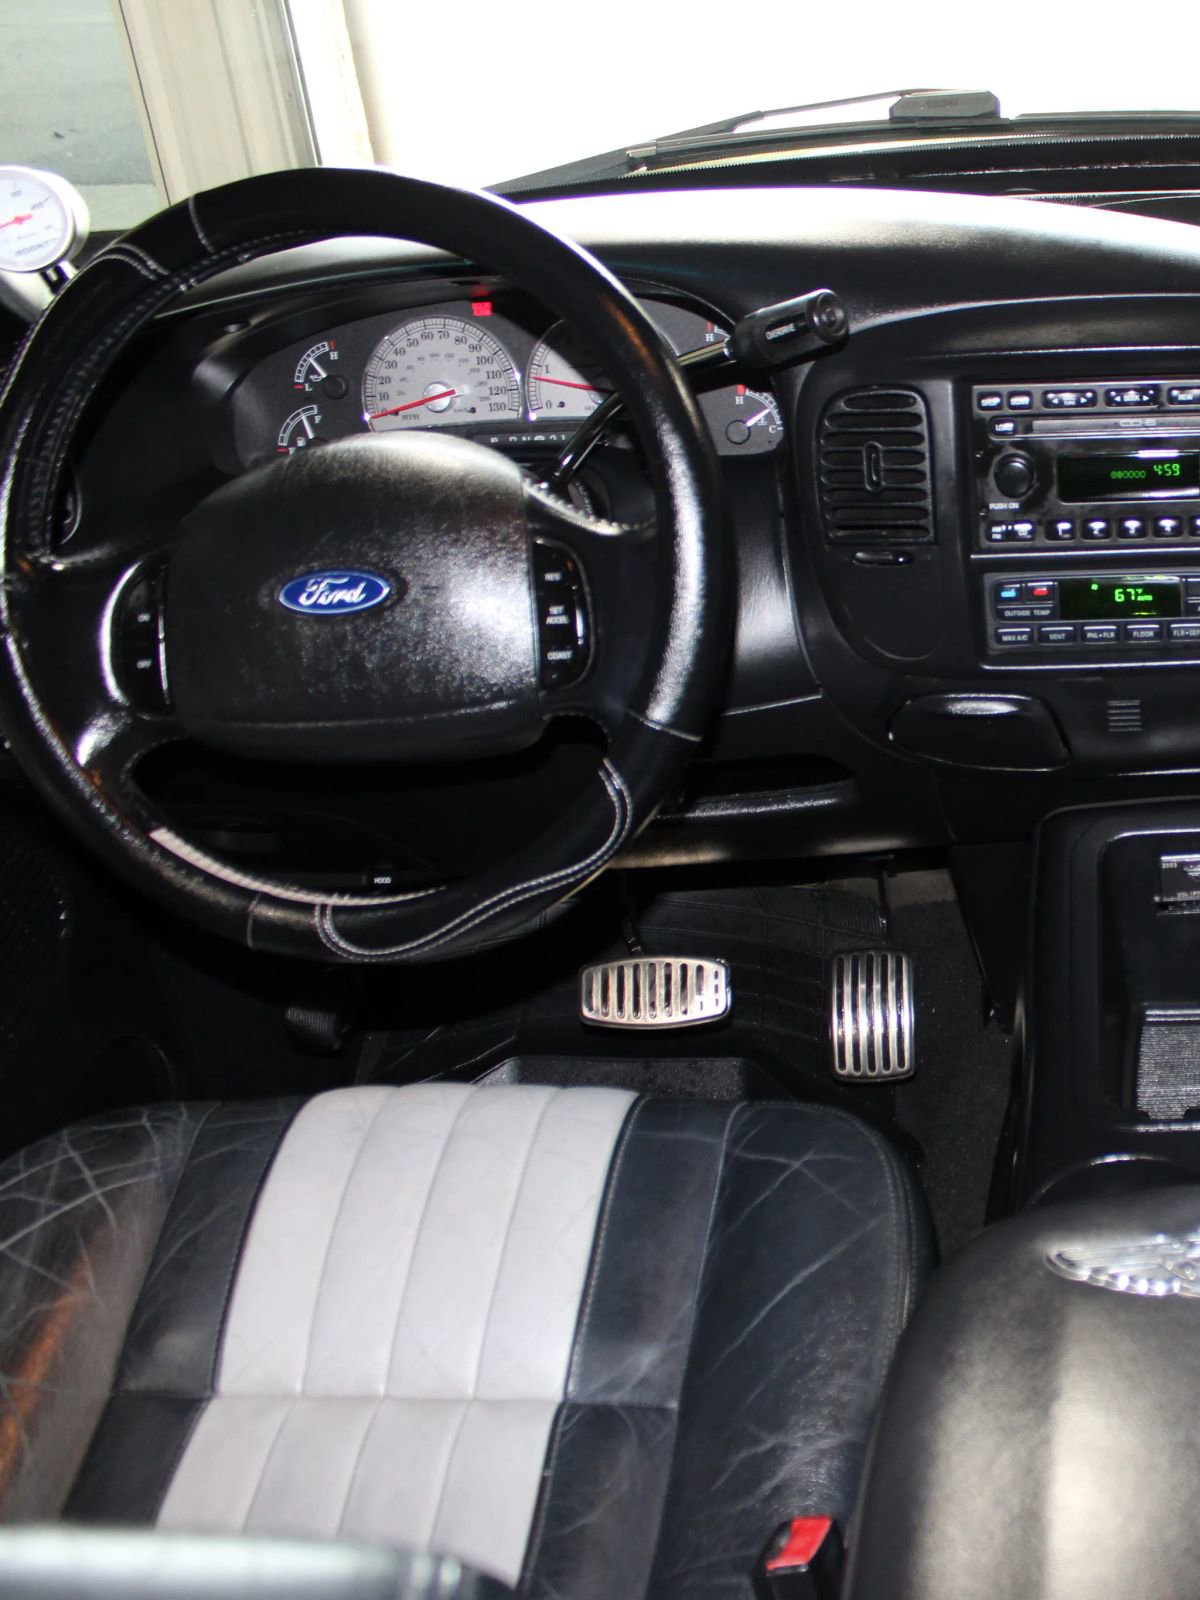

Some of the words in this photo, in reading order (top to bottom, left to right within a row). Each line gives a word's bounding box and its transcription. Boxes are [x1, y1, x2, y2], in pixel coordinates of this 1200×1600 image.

[421, 331, 433, 341] 60
[437, 330, 450, 340] 70
[454, 335, 468, 345] 80
[706, 333, 715, 342] H
[406, 338, 419, 348] 50
[468, 343, 482, 353] 90
[330, 351, 339, 360] H
[393, 347, 406, 357] 40
[384, 360, 398, 370] 30
[476, 355, 494, 365] 100
[544, 364, 551, 374] 1
[486, 370, 502, 380] 110
[378, 376, 391, 385] 20
[304, 383, 313, 392] L
[488, 386, 507, 396] 120
[379, 392, 390, 401] 10
[735, 396, 744, 405] H
[1123, 394, 1141, 402] SEEK
[488, 402, 507, 412] 130
[545, 400, 552, 409] 0
[768, 425, 776, 433] C
[1153, 463, 1180, 476] 4:59
[989, 502, 1008, 510] PUSH
[544, 572, 562, 581] RES
[298, 576, 368, 606] Ford
[1114, 588, 1136, 602] 67
[548, 605, 565, 615] SET
[137, 613, 151, 622] ON
[545, 615, 569, 625] ACCEL
[547, 650, 573, 661] COAST
[136, 660, 152, 669] OFF
